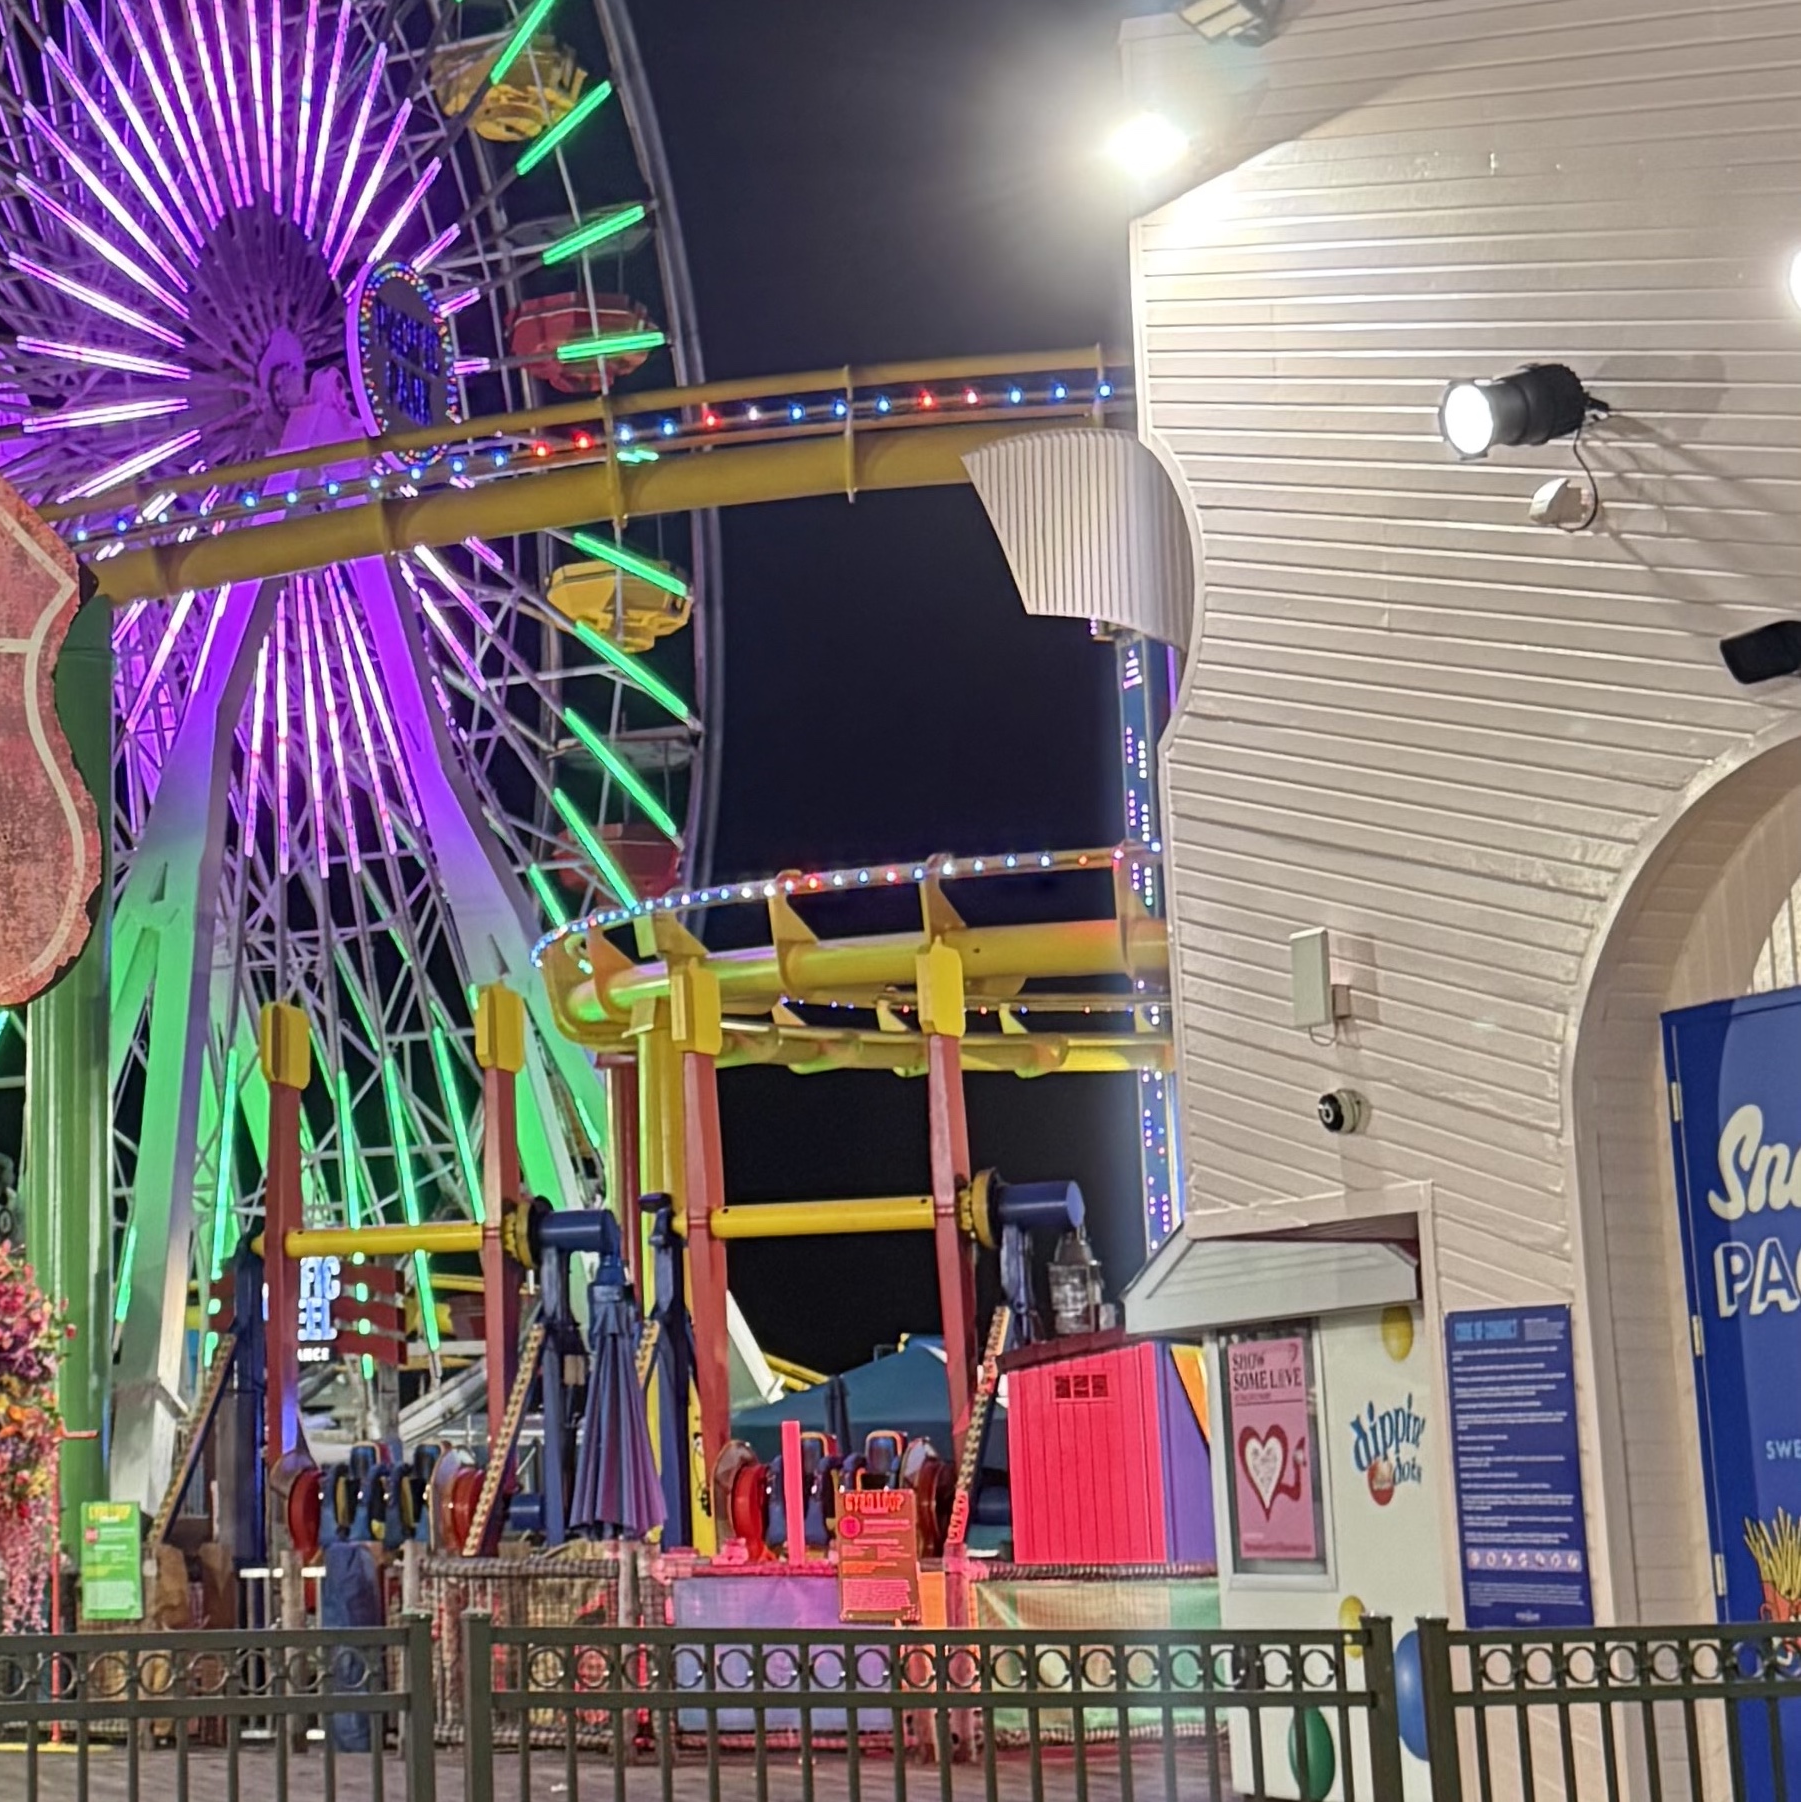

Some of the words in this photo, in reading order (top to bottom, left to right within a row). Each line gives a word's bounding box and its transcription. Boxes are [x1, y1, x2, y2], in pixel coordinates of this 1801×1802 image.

[1708, 1104, 1801, 1220] Sn
[1713, 1237, 1801, 1318] PA
[1234, 1370, 1268, 1391] SOME
